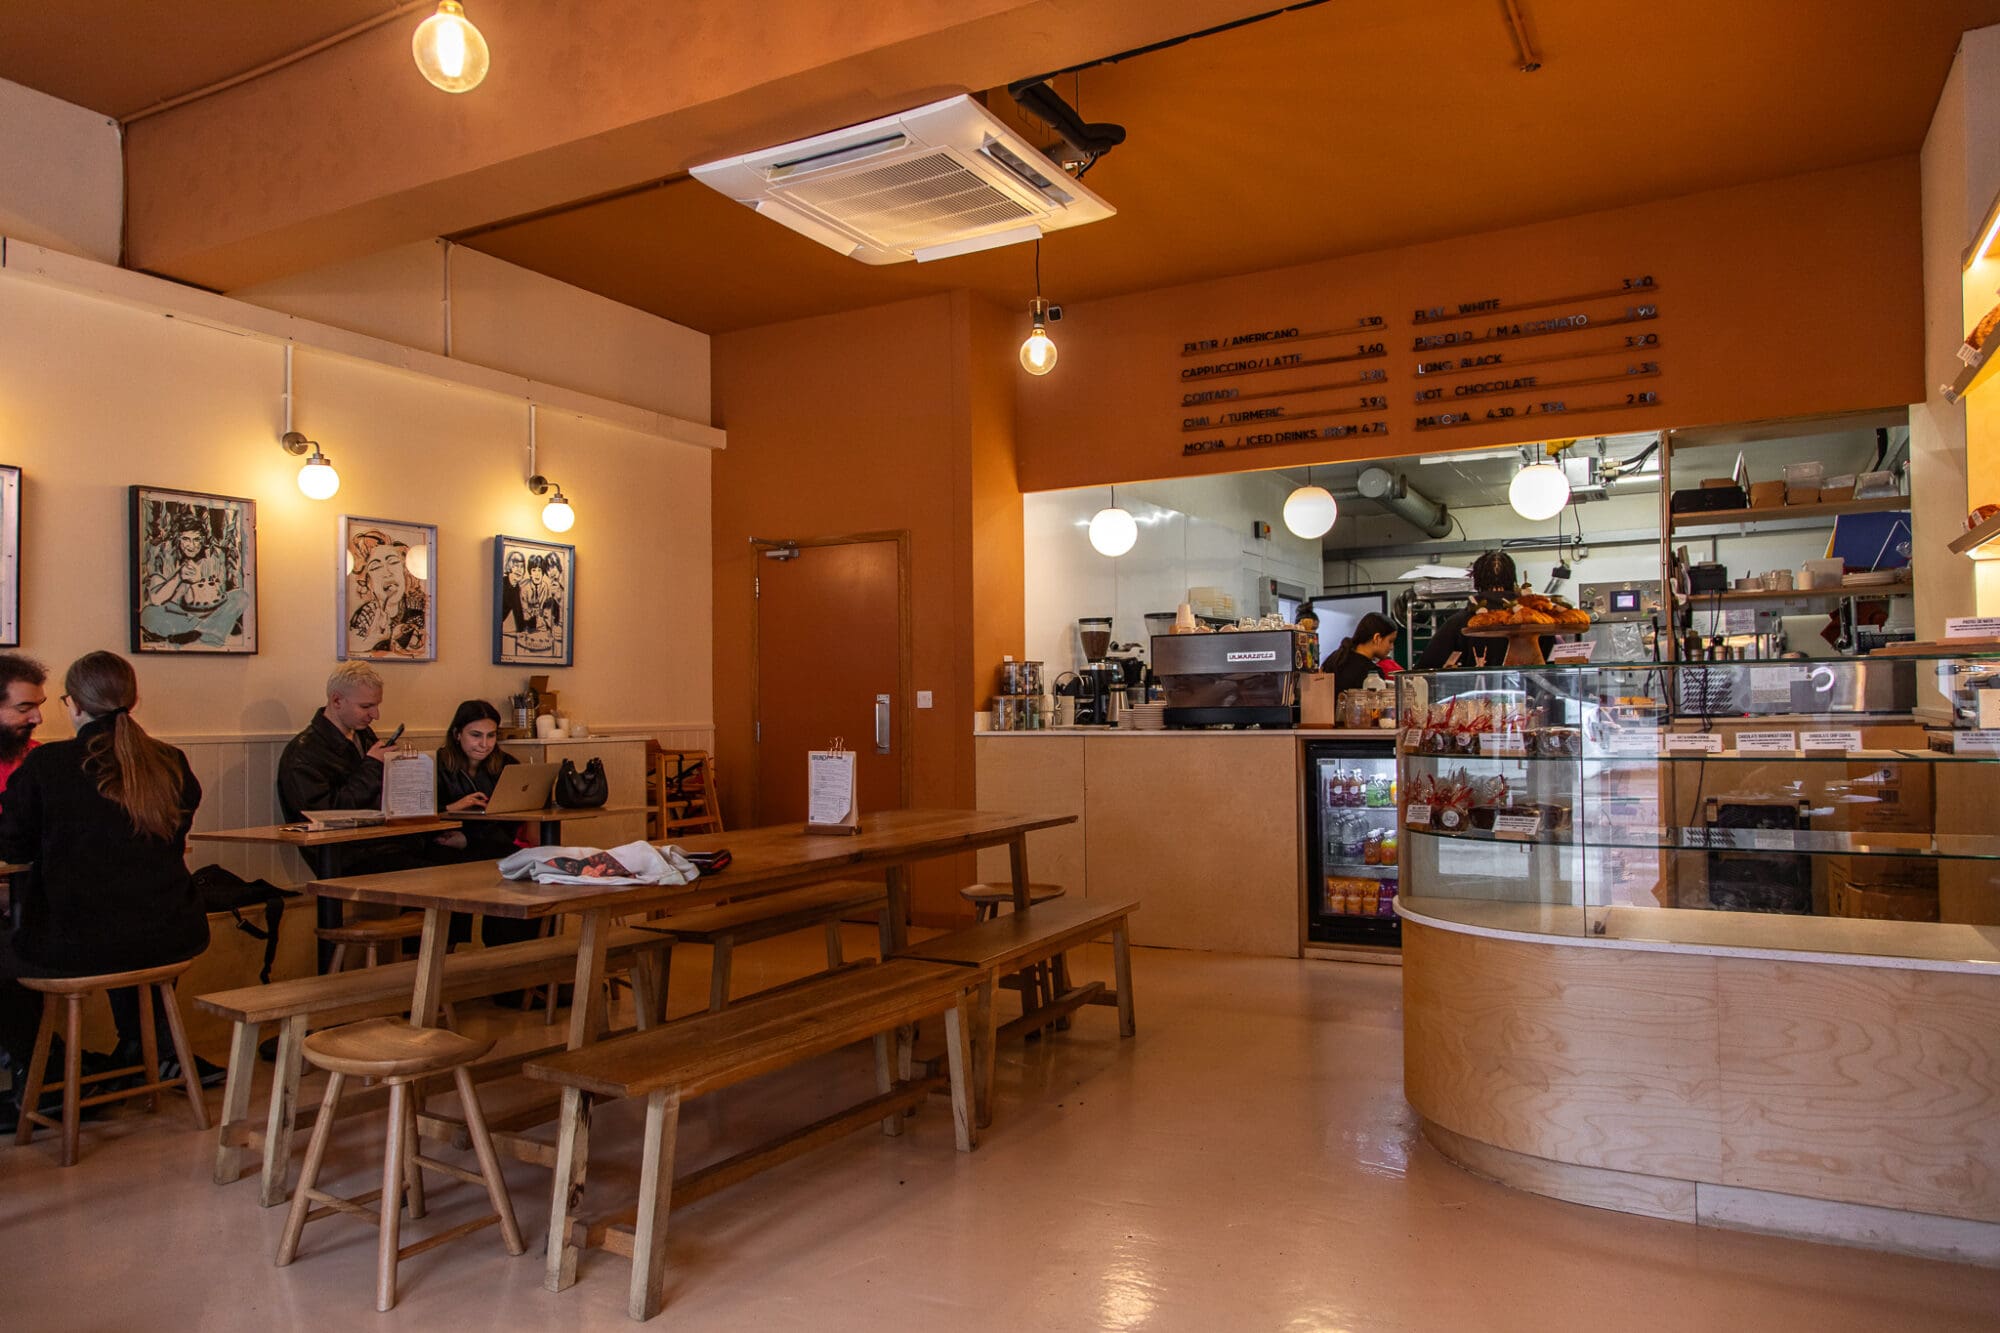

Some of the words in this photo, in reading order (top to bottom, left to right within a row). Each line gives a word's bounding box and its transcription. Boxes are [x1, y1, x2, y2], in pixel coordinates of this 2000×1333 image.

[1414, 307, 1444, 320] FLAT
[1458, 299, 1500, 314] WHITE
[1496, 314, 1588, 336] MACCHIATO
[1223, 338, 1228, 347] /
[1232, 328, 1299, 345] AMERICANO
[1417, 361, 1452, 374] LONG
[1460, 354, 1503, 369] BLACK
[1416, 388, 1443, 401] HOT
[1455, 377, 1536, 397] CHOCOLATE
[1229, 407, 1285, 423] TURMERIC
[1416, 413, 1471, 428] MATCHA
[1184, 440, 1225, 452] MOCHA
[1246, 433, 1273, 446] ICED
[1275, 429, 1318, 443] DRINKS
